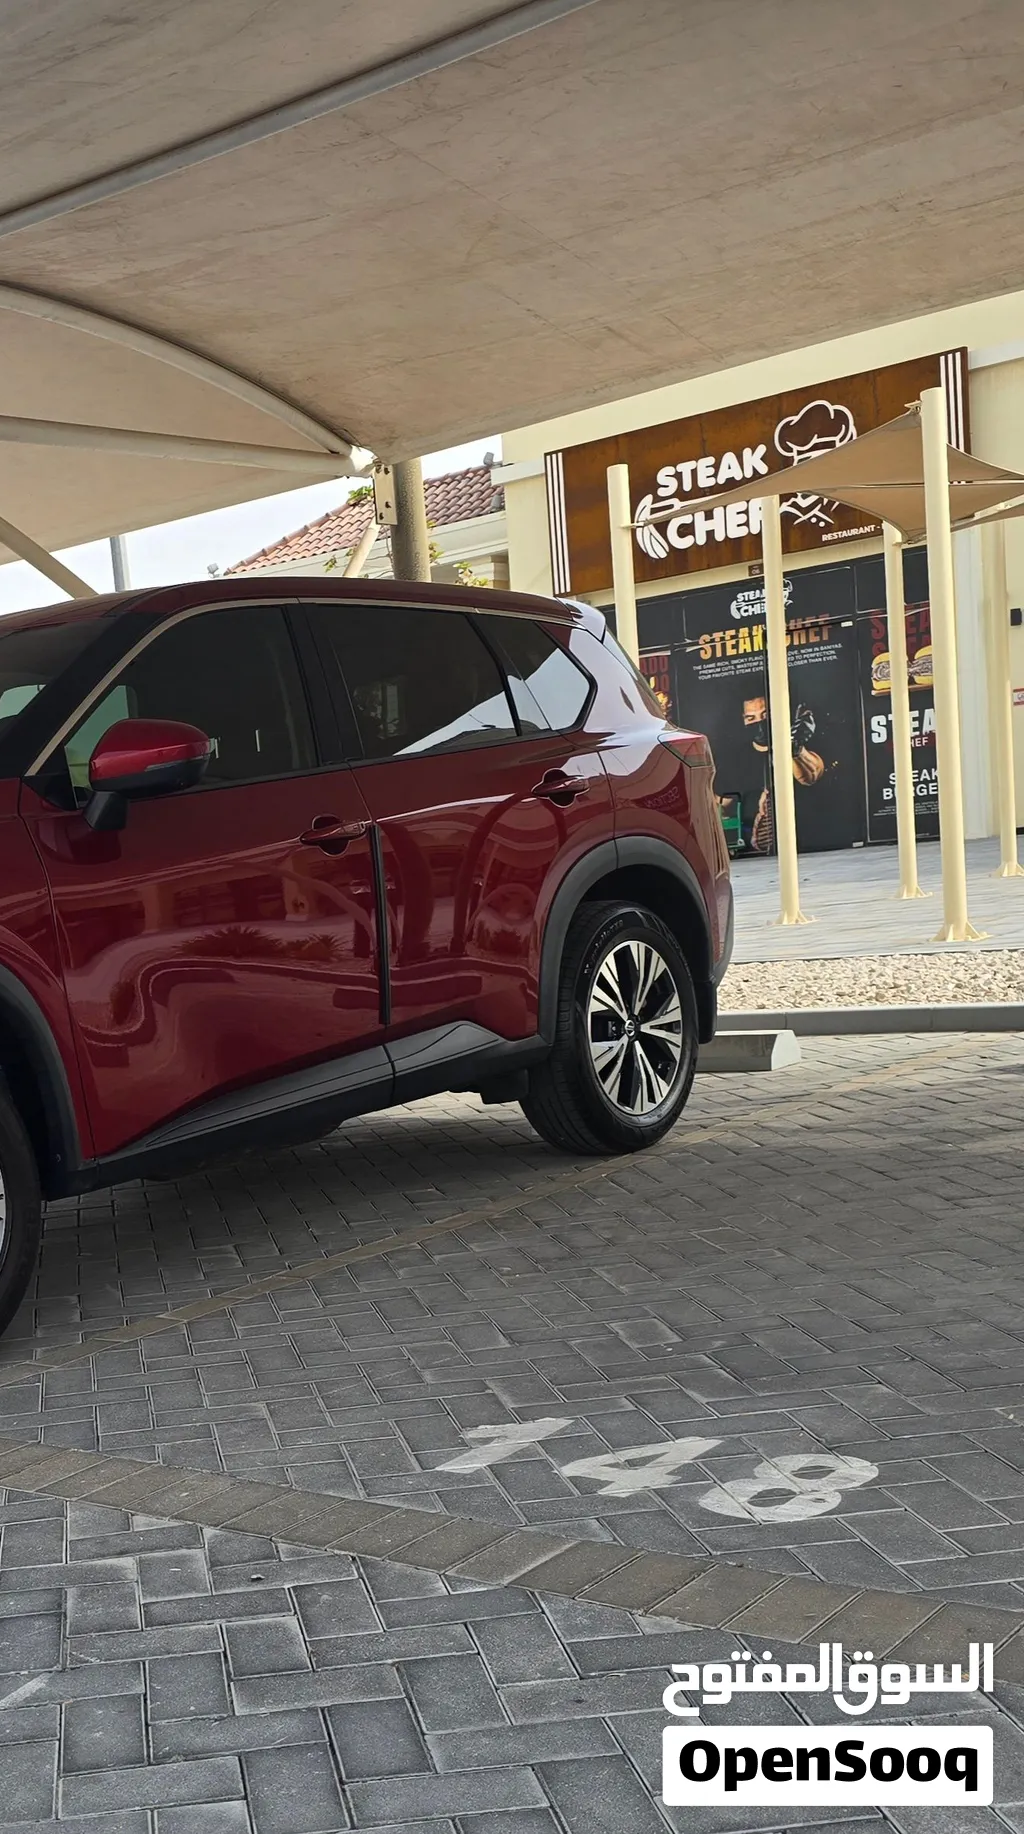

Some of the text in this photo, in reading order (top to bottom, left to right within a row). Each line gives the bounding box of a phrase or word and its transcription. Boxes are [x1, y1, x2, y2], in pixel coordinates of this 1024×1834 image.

[656, 444, 769, 497] STEAK
[821, 524, 876, 541] RESTAURANT
[889, 768, 939, 785] SEAK
[433, 1416, 879, 1523] 148
